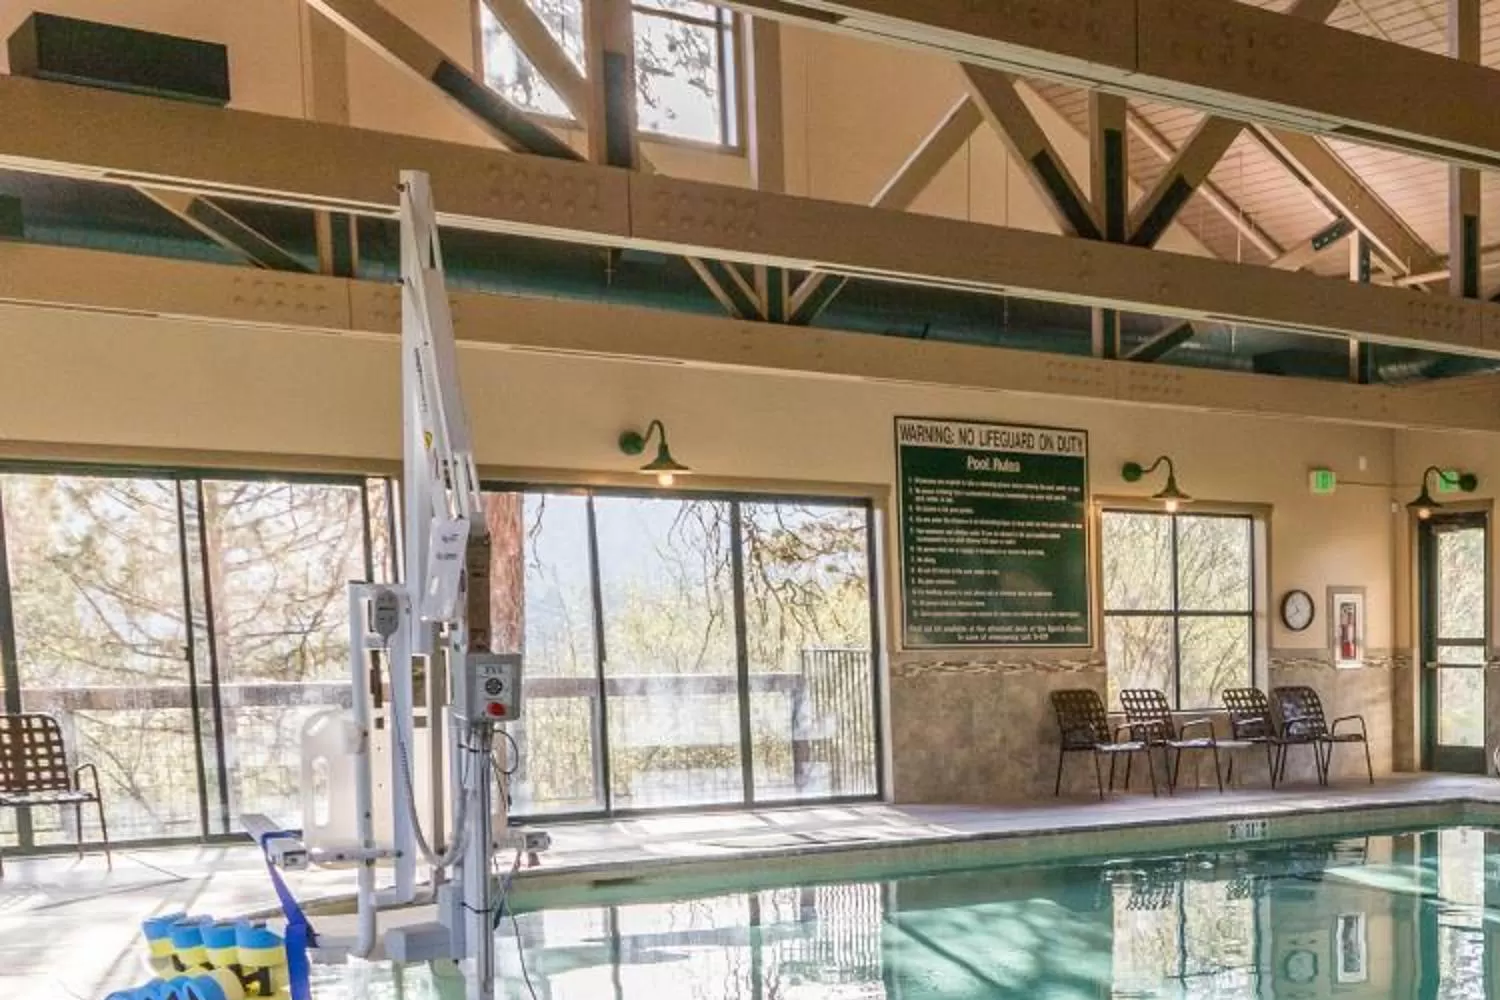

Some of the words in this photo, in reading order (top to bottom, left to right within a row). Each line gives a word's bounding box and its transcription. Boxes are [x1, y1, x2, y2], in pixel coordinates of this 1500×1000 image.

[900, 423, 954, 443] WARNING:
[958, 427, 974, 445] NO
[979, 429, 1035, 448] LIFEGUARD
[1040, 433, 1054, 450] ON
[1057, 435, 1083, 452] DUTY
[967, 455, 991, 471] Pool
[993, 457, 1021, 473] Rules
